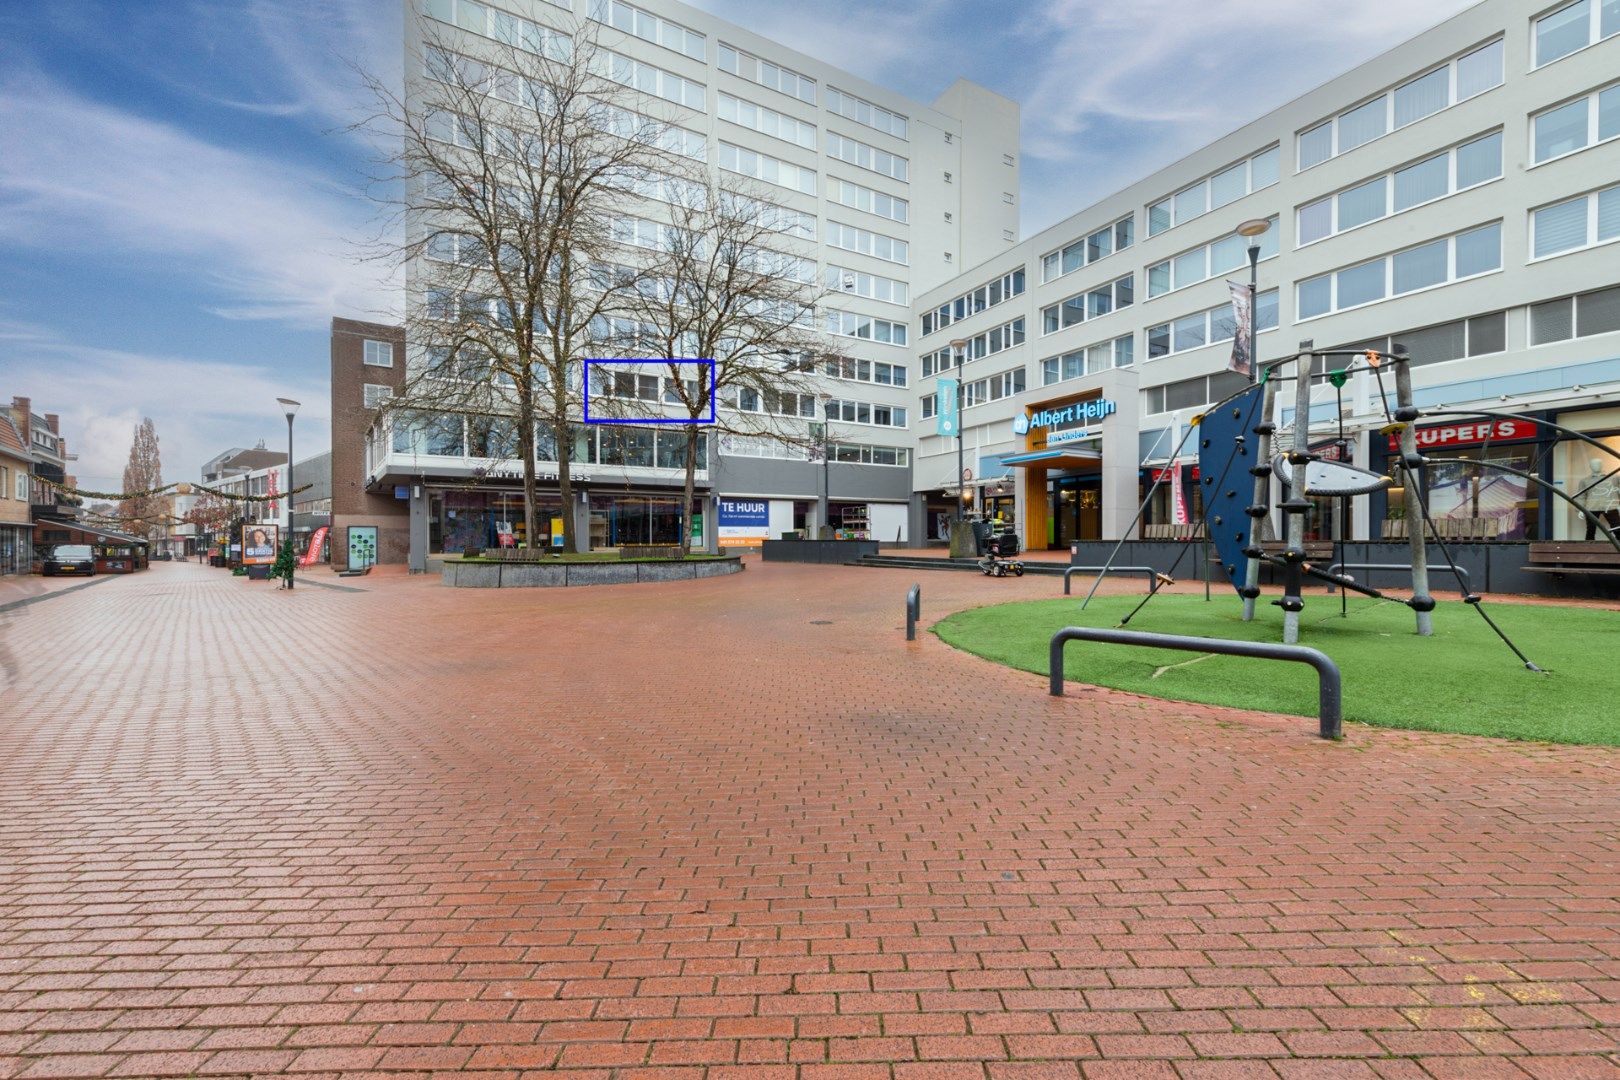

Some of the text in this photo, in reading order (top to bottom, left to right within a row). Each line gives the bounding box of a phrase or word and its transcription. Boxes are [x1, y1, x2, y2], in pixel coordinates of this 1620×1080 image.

[1030, 399, 1115, 428] Albert Heijn
[1415, 422, 1516, 444] UPERS
[485, 470, 591, 481] ANYTIE FITESS
[722, 502, 765, 513] TE HUUR
